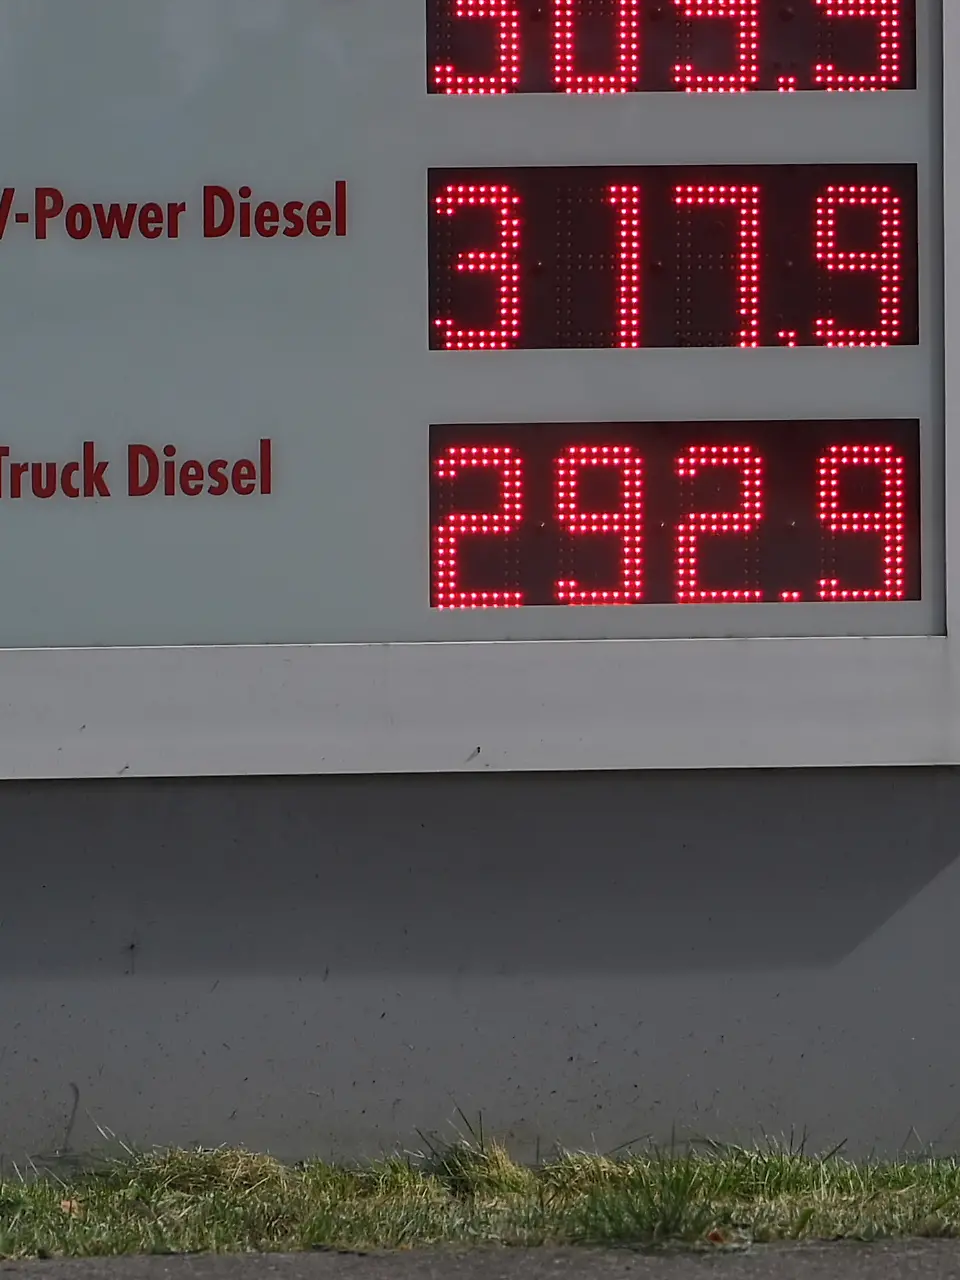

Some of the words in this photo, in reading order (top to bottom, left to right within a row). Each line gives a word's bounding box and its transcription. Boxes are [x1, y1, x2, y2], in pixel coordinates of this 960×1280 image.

[205, 182, 347, 238] Diesel
[434, 182, 902, 350] 317.9
[129, 439, 272, 496] Diesel
[434, 442, 905, 608] 292.9
